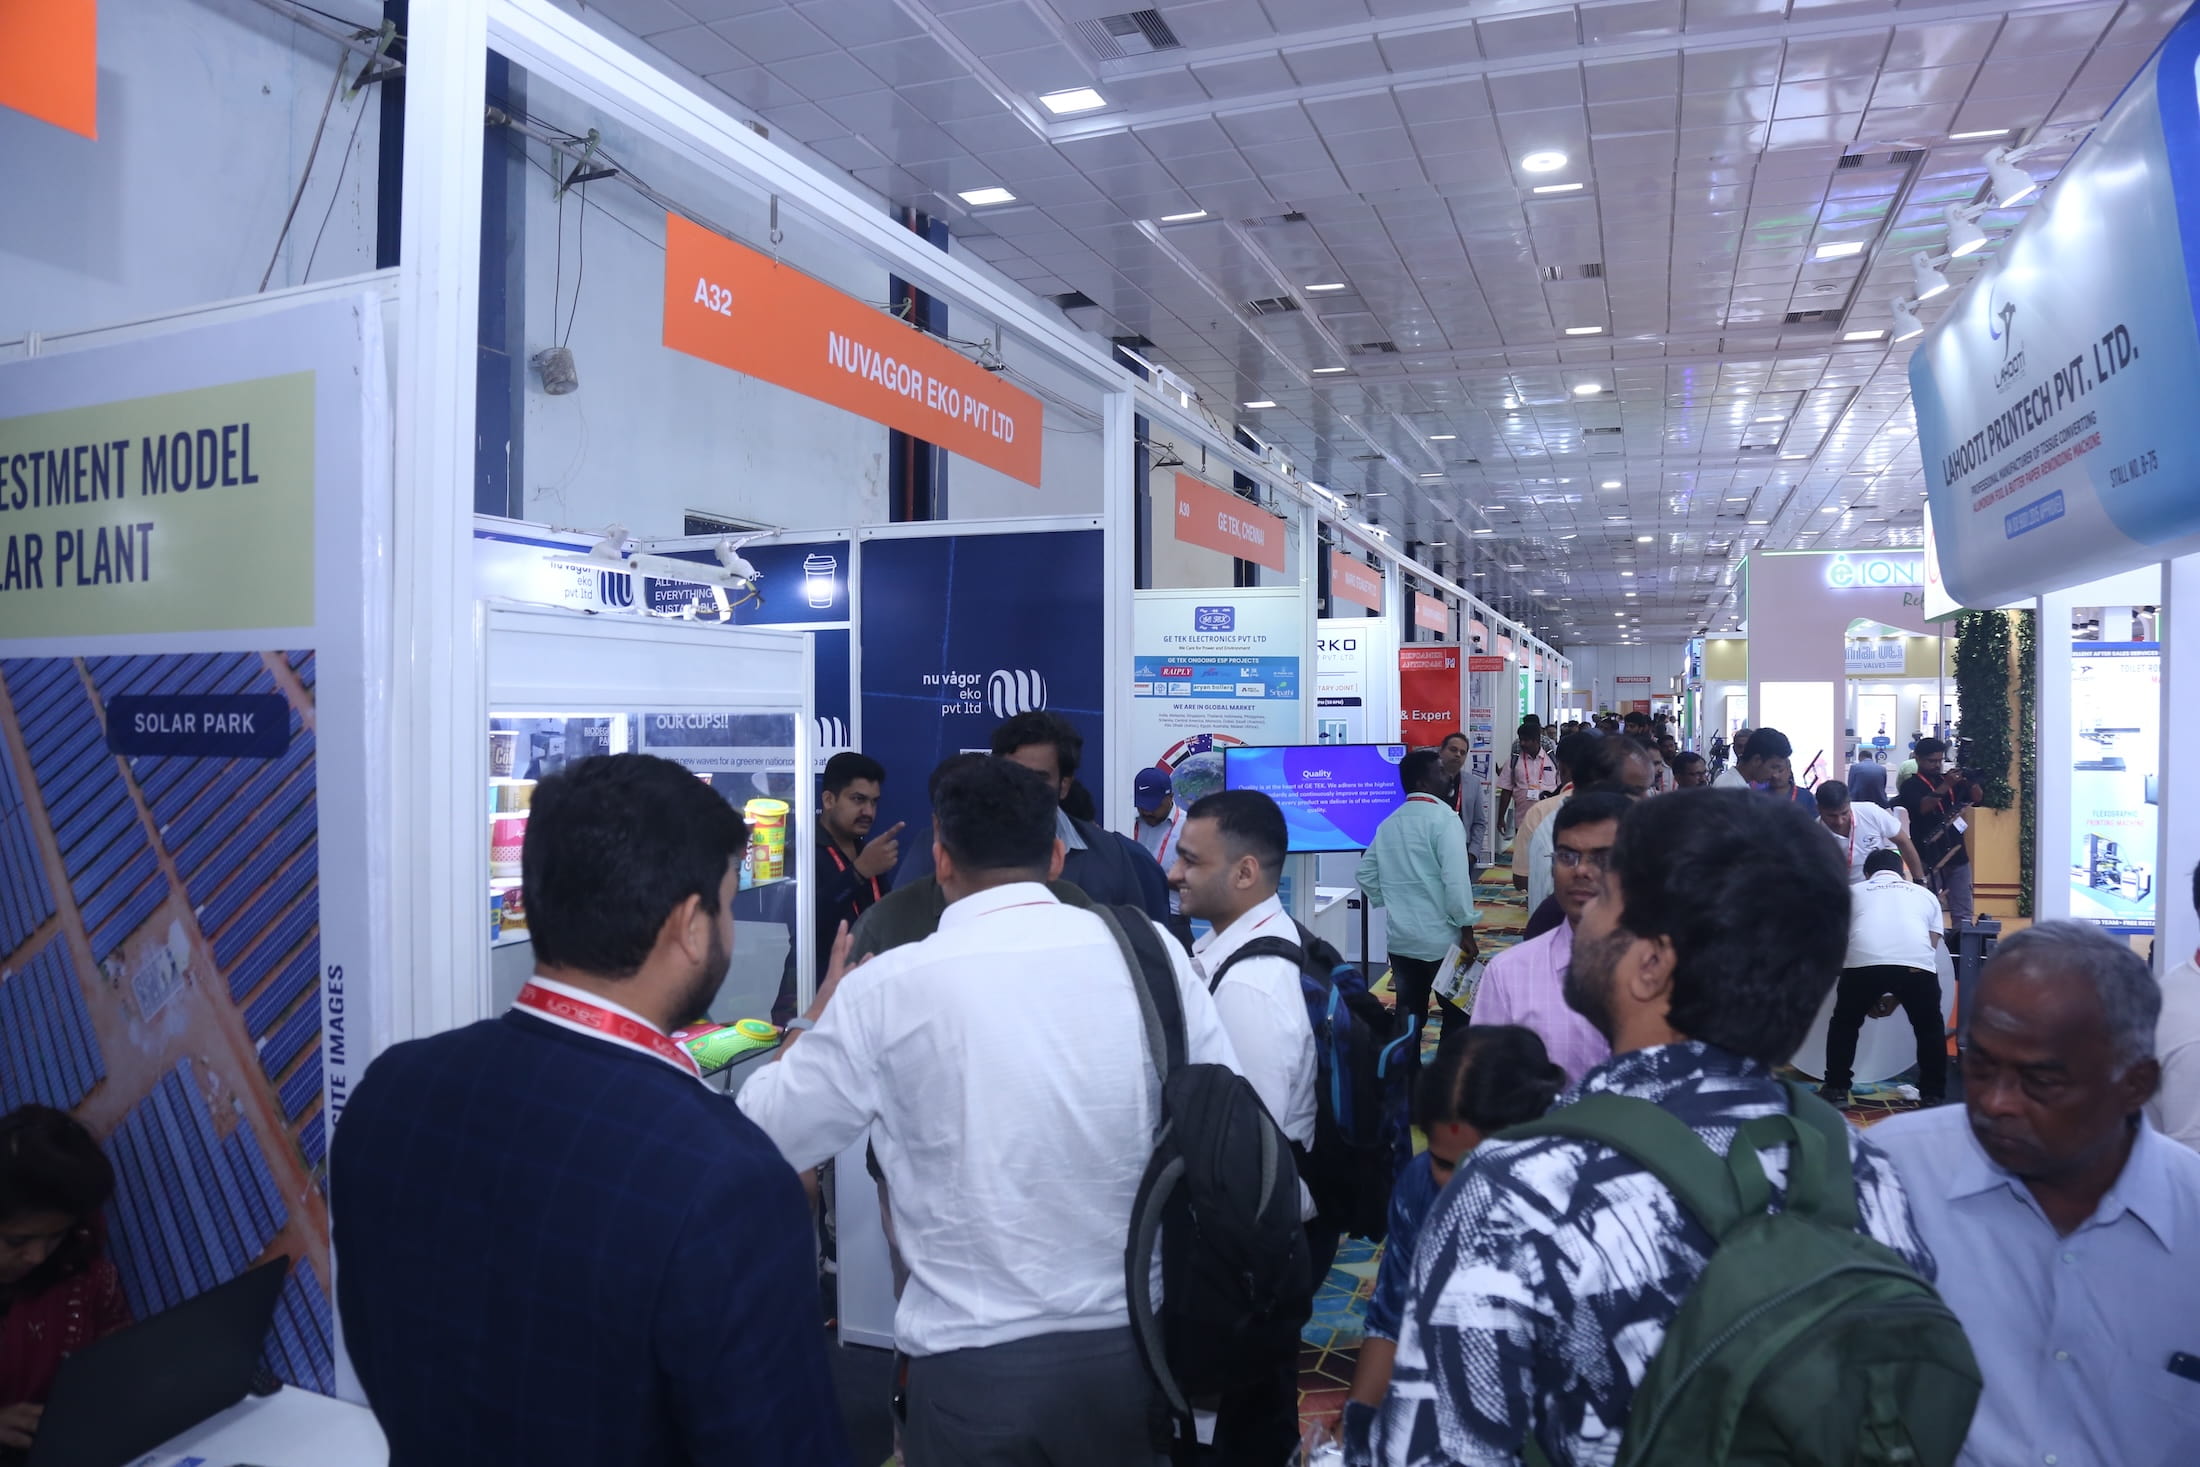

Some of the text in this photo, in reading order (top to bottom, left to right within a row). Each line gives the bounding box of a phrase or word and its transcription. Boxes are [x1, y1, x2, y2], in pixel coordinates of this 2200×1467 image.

[694, 278, 732, 317] A32
[828, 331, 1015, 444] NUVAGOR EKO PVT LTD
[1942, 430, 1988, 487] LAHOOTI
[1987, 380, 2053, 456] PRINTECH
[2053, 355, 2093, 411] PVT.
[2093, 324, 2139, 384] LTD.
[141, 423, 260, 496] MODEL
[1178, 500, 1190, 517] A30
[1218, 511, 1228, 533] GE
[0, 522, 154, 591] AR PLANT
[577, 577, 593, 586] eko
[565, 587, 593, 599] pvt ltd
[655, 588, 713, 601] EVERYTHING
[1163, 635, 1172, 643] GE
[1175, 635, 1187, 643] TEK
[1188, 635, 1236, 643] ELECTRONICS
[1238, 635, 1251, 643] PVT
[923, 671, 981, 688] nu vågor
[1162, 667, 1192, 676] RAIPLY
[959, 687, 982, 700] eko
[942, 701, 982, 717] pvt ltd
[1401, 710, 1451, 722] & Expert
[134, 713, 256, 734] SOLAR PARK
[656, 713, 729, 729] OUR CUPS!!
[719, 756, 729, 765] for
[736, 758, 763, 767] greener
[1302, 770, 1332, 778] Quality
[328, 964, 345, 1065] IMAGES
